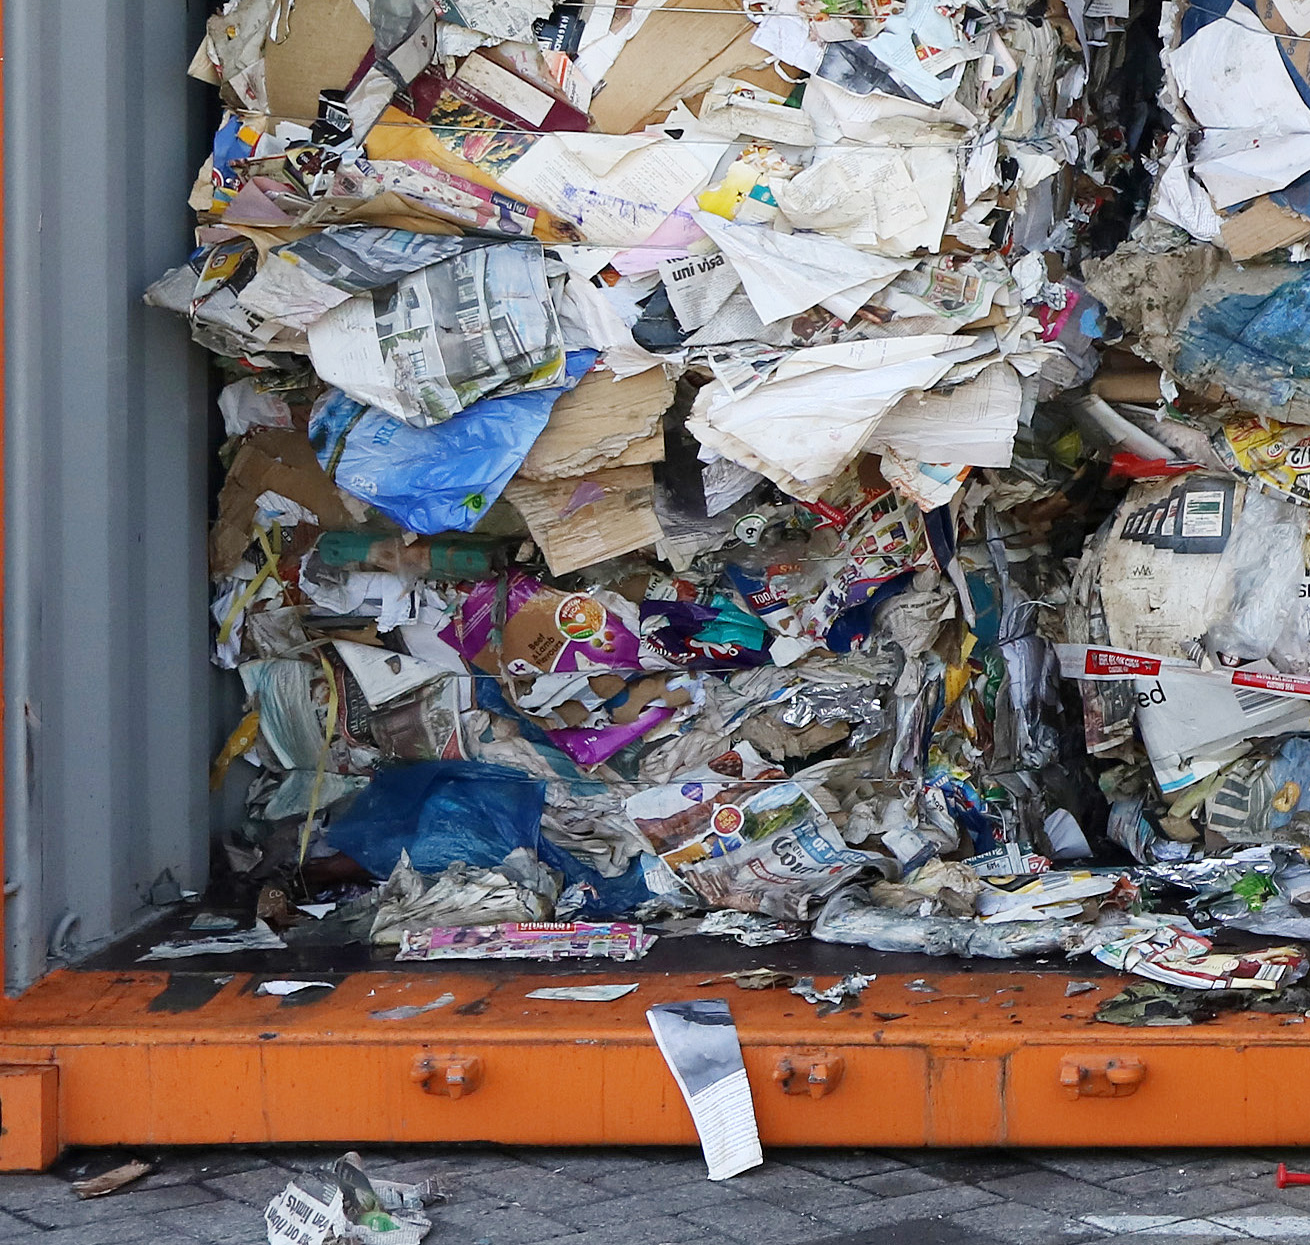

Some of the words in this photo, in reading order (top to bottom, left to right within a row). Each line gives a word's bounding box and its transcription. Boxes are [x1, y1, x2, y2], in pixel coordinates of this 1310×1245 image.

[672, 260, 695, 282] uni
[697, 254, 725, 273] visa
[527, 633, 544, 650] Beef
[537, 636, 555, 655] Lamb
[1137, 680, 1167, 708] ed
[812, 839, 828, 852] OF
[286, 1195, 312, 1225] limits
[286, 1226, 299, 1242] on
